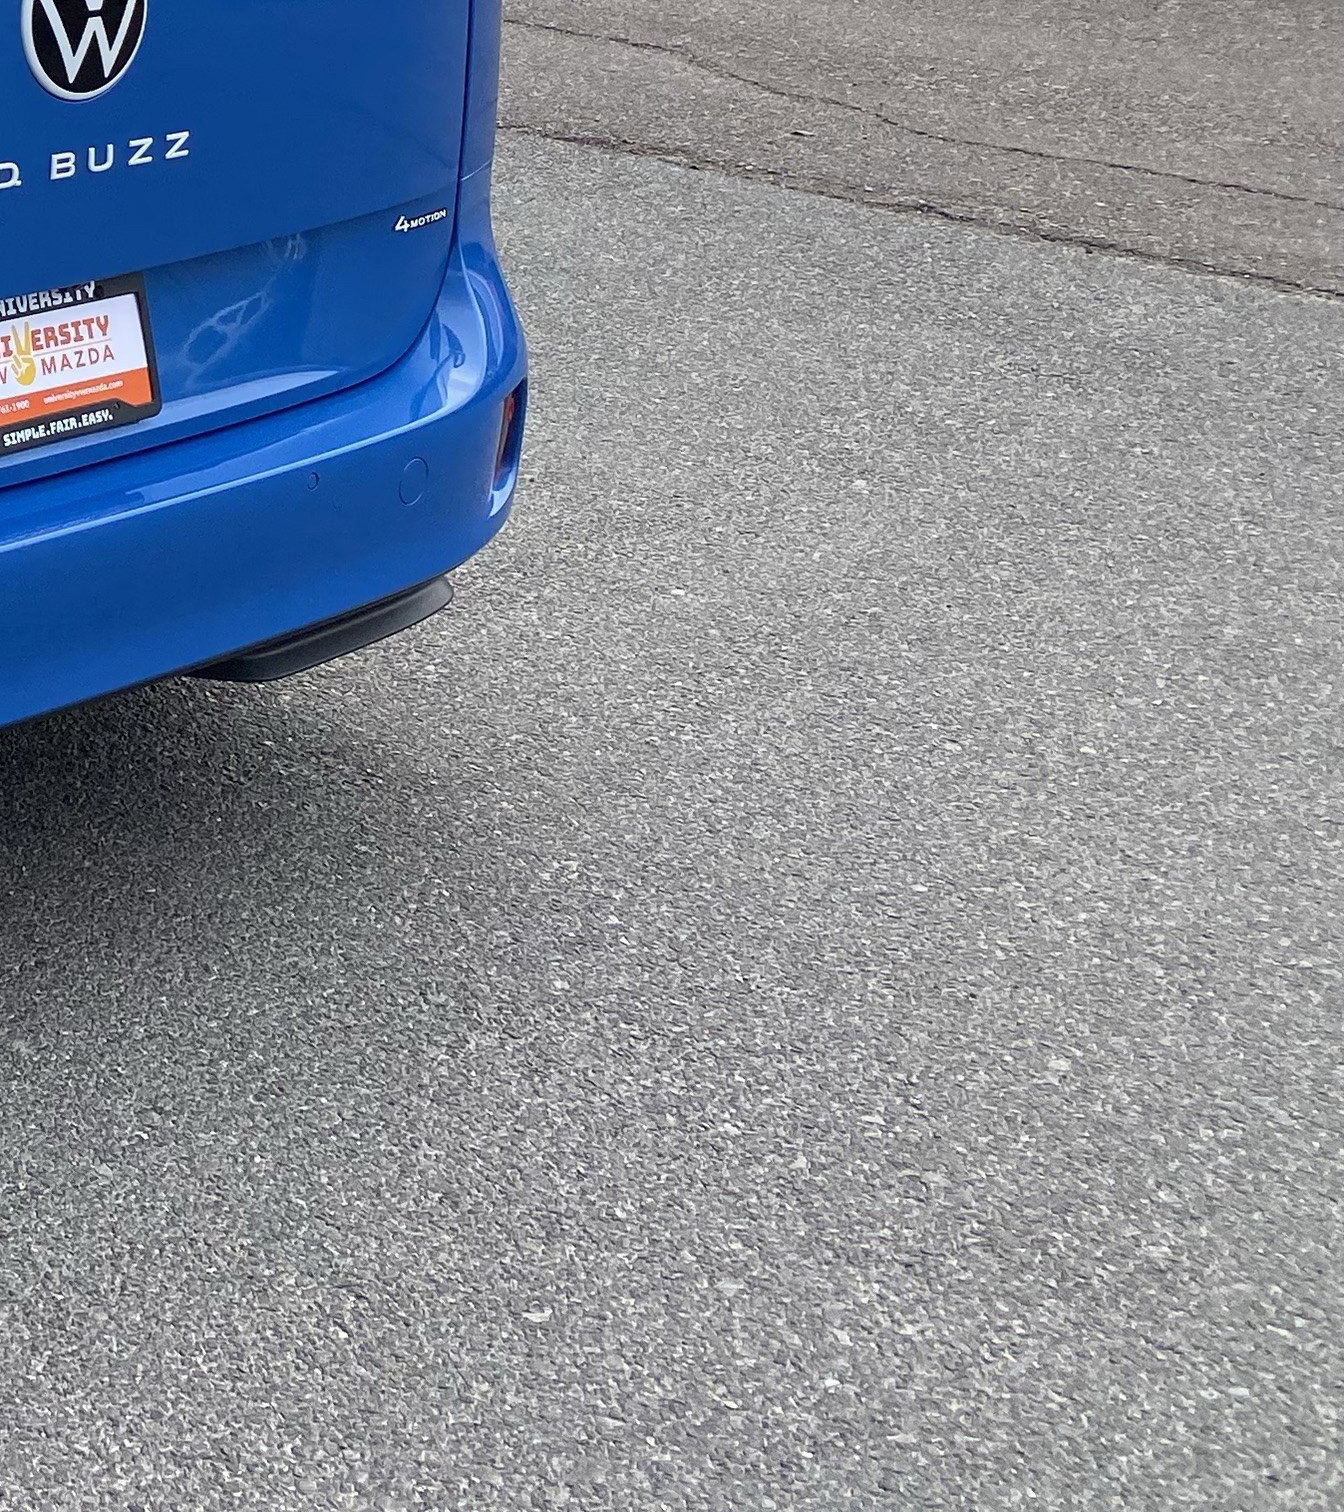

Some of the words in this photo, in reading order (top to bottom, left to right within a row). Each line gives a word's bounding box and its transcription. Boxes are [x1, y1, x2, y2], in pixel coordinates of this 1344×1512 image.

[50, 130, 190, 181] BUZZ
[394, 208, 447, 233] 4MOTION
[40, 344, 115, 376] MAZDA
